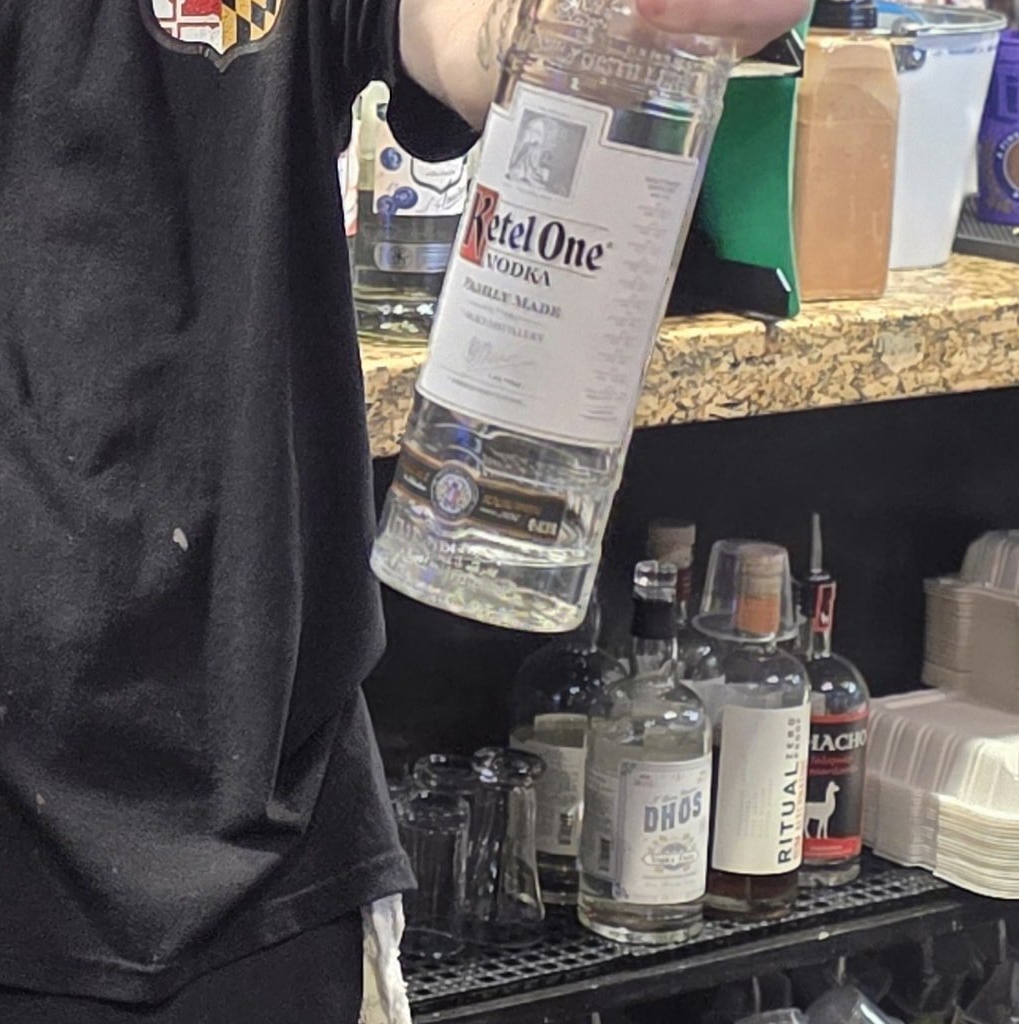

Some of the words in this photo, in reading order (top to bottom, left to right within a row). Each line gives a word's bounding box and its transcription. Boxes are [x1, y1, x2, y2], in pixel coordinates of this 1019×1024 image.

[463, 188, 537, 262] Ketel
[538, 220, 604, 271] One
[486, 252, 551, 287] VODKA
[512, 290, 562, 319] MADE
[808, 728, 867, 753] HACHO
[643, 790, 702, 833] DHOS
[778, 760, 799, 865] RITUAL
